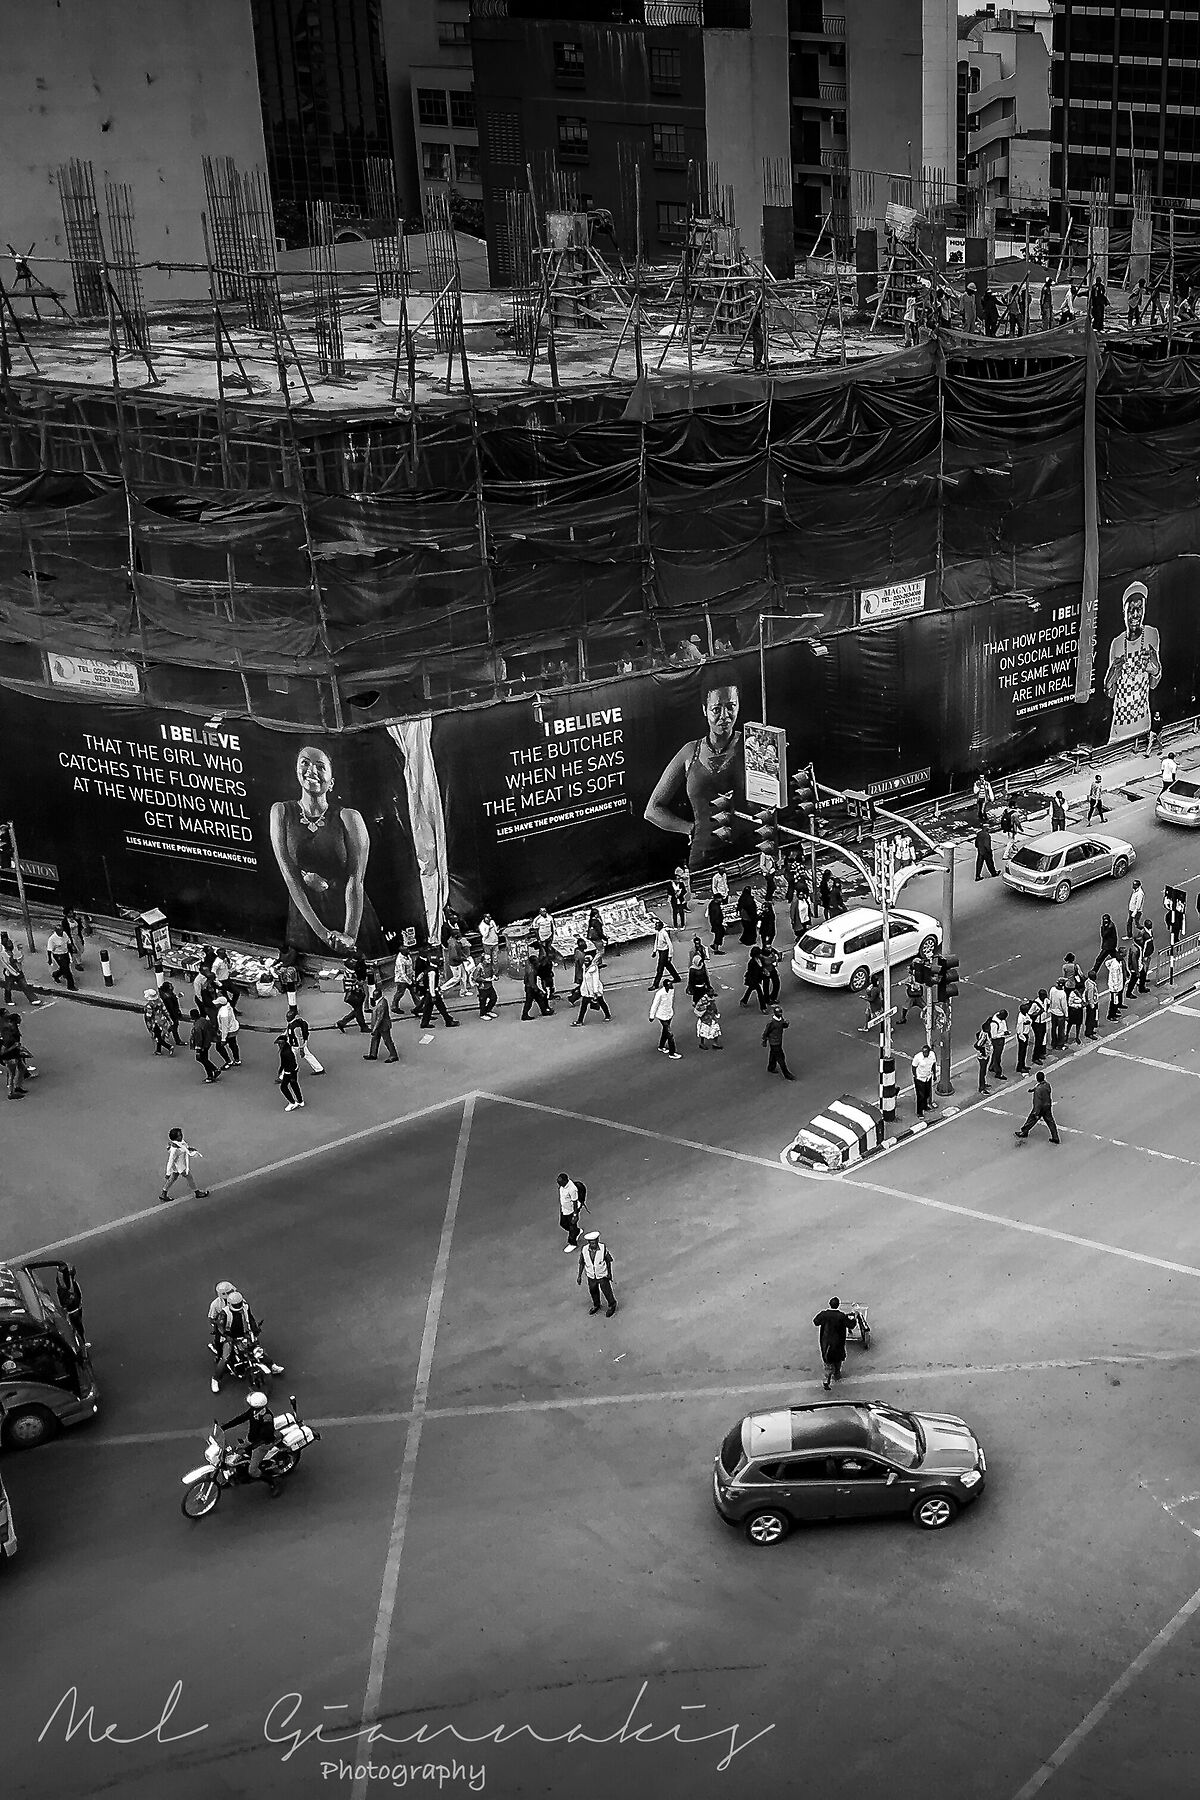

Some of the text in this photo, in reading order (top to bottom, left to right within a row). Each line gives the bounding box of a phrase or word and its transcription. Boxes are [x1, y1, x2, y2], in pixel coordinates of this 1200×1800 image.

[884, 582, 921, 597] MAGNATE
[1052, 599, 1099, 621] I BELIVE
[983, 621, 1077, 656] THAT HOW PEOPLE
[998, 658, 1072, 689] THE SAME WAY
[999, 655, 1016, 671] ON
[1017, 646, 1054, 667] SOCIAL
[1011, 686, 1033, 703] ARE
[1035, 682, 1047, 697] IN
[1047, 675, 1074, 693] REAL
[160, 724, 242, 751] I BELIEVE
[544, 707, 623, 737] I BELIEVE
[83, 733, 243, 774] THAT THE GIRL WHO
[510, 729, 623, 766] THE BUTCHER
[59, 752, 247, 797] CATCHES THE FLOWERS
[505, 750, 625, 790] WHEN HE SAYS
[73, 776, 251, 820] AT THE WEDDING WILL
[483, 770, 626, 817] THE MEAT IS SOFT
[145, 811, 253, 842] GET MARRIED
[496, 798, 627, 836] LIES HAVE THE POWER TO CHANGE YOU
[126, 836, 257, 865] LIES HAVE THE POWER TO CHANGE YOU
